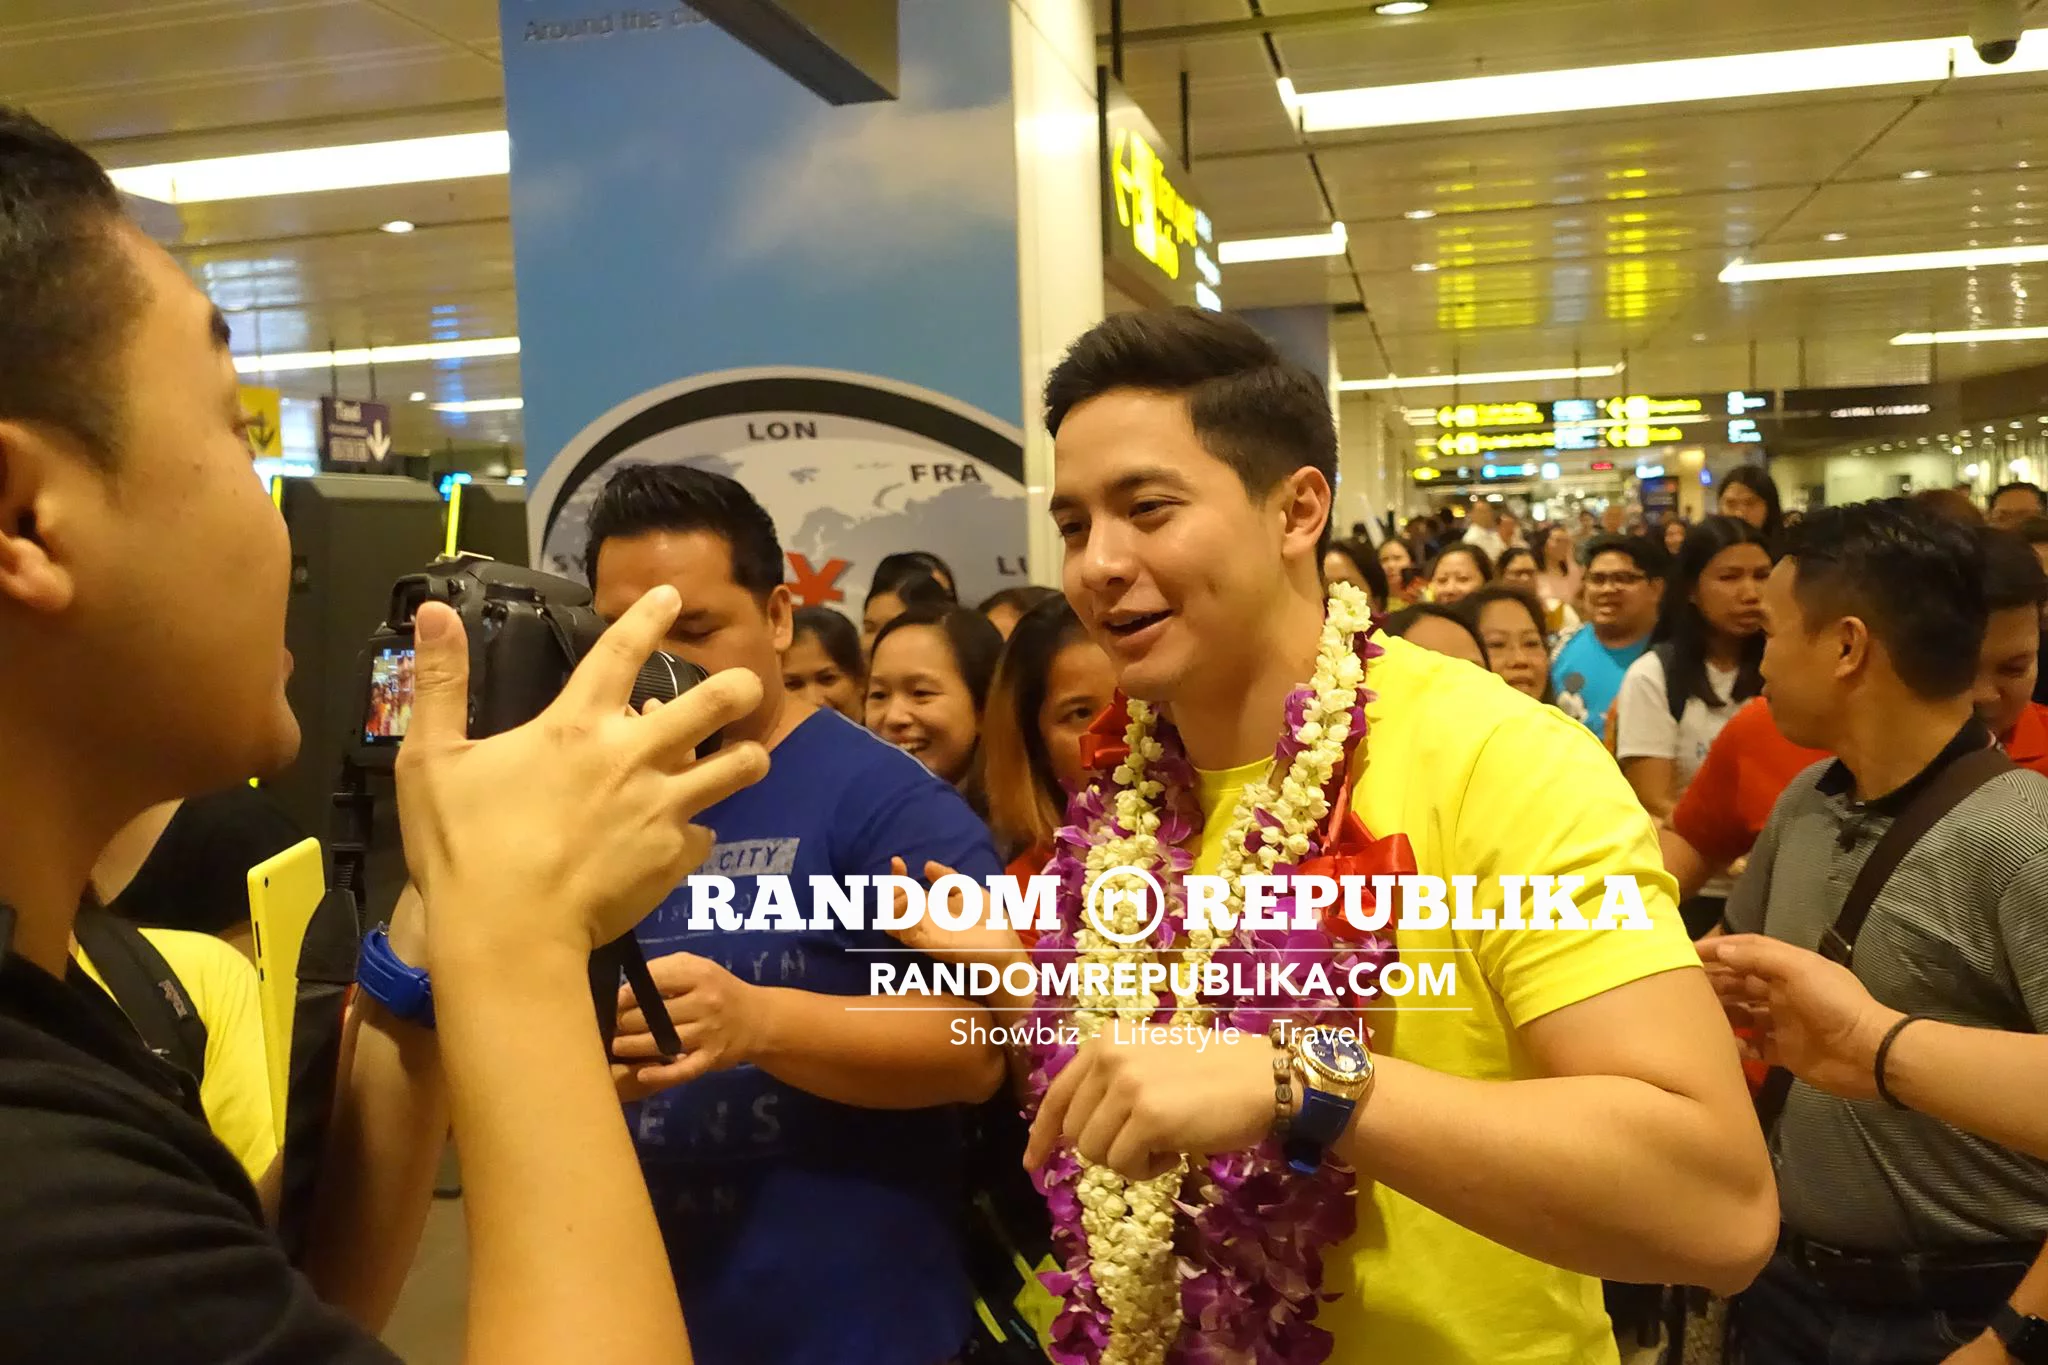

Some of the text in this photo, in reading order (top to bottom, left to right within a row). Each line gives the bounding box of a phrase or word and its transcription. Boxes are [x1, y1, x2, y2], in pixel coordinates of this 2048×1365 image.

[524, 15, 615, 42] Around
[620, 10, 664, 30] the
[746, 421, 817, 441] LON
[909, 463, 982, 483] FRA
[552, 554, 586, 573] SY
[719, 845, 780, 872] CITY
